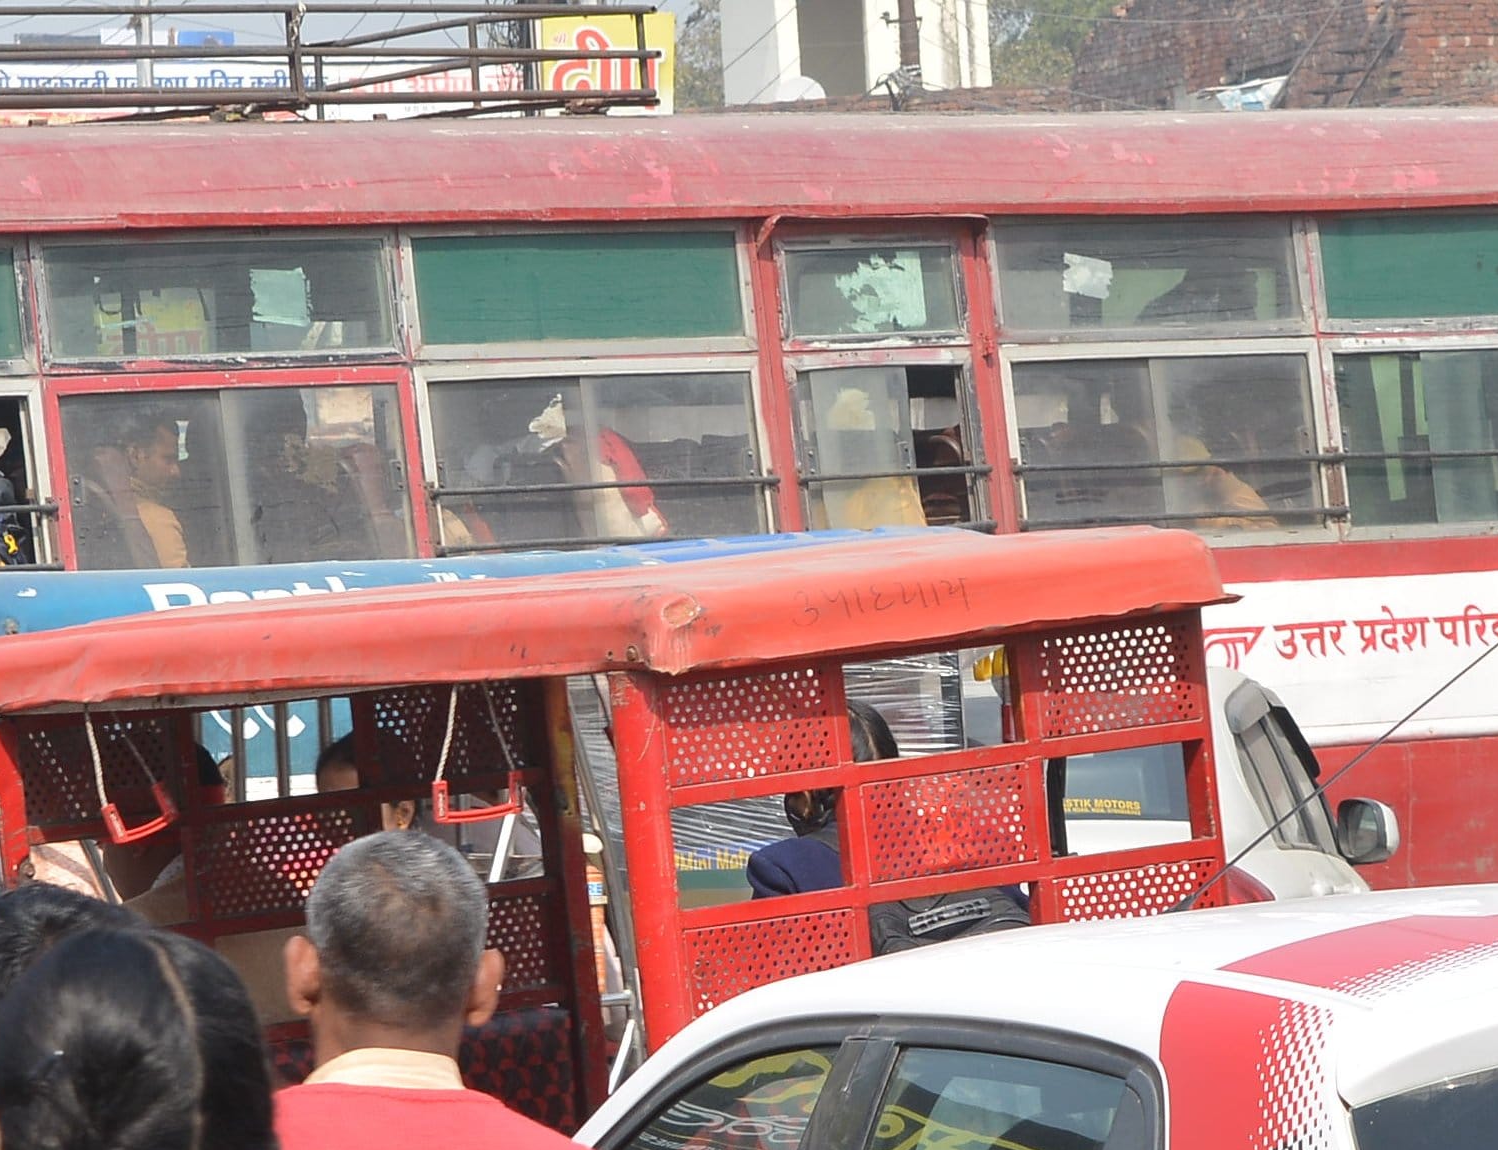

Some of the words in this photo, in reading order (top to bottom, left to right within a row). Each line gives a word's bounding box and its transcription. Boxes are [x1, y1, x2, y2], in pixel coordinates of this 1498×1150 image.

[1274, 620, 1348, 661] उत्तर
[1354, 605, 1430, 654] प्रदेश
[1094, 799, 1141, 810] MOTORS
